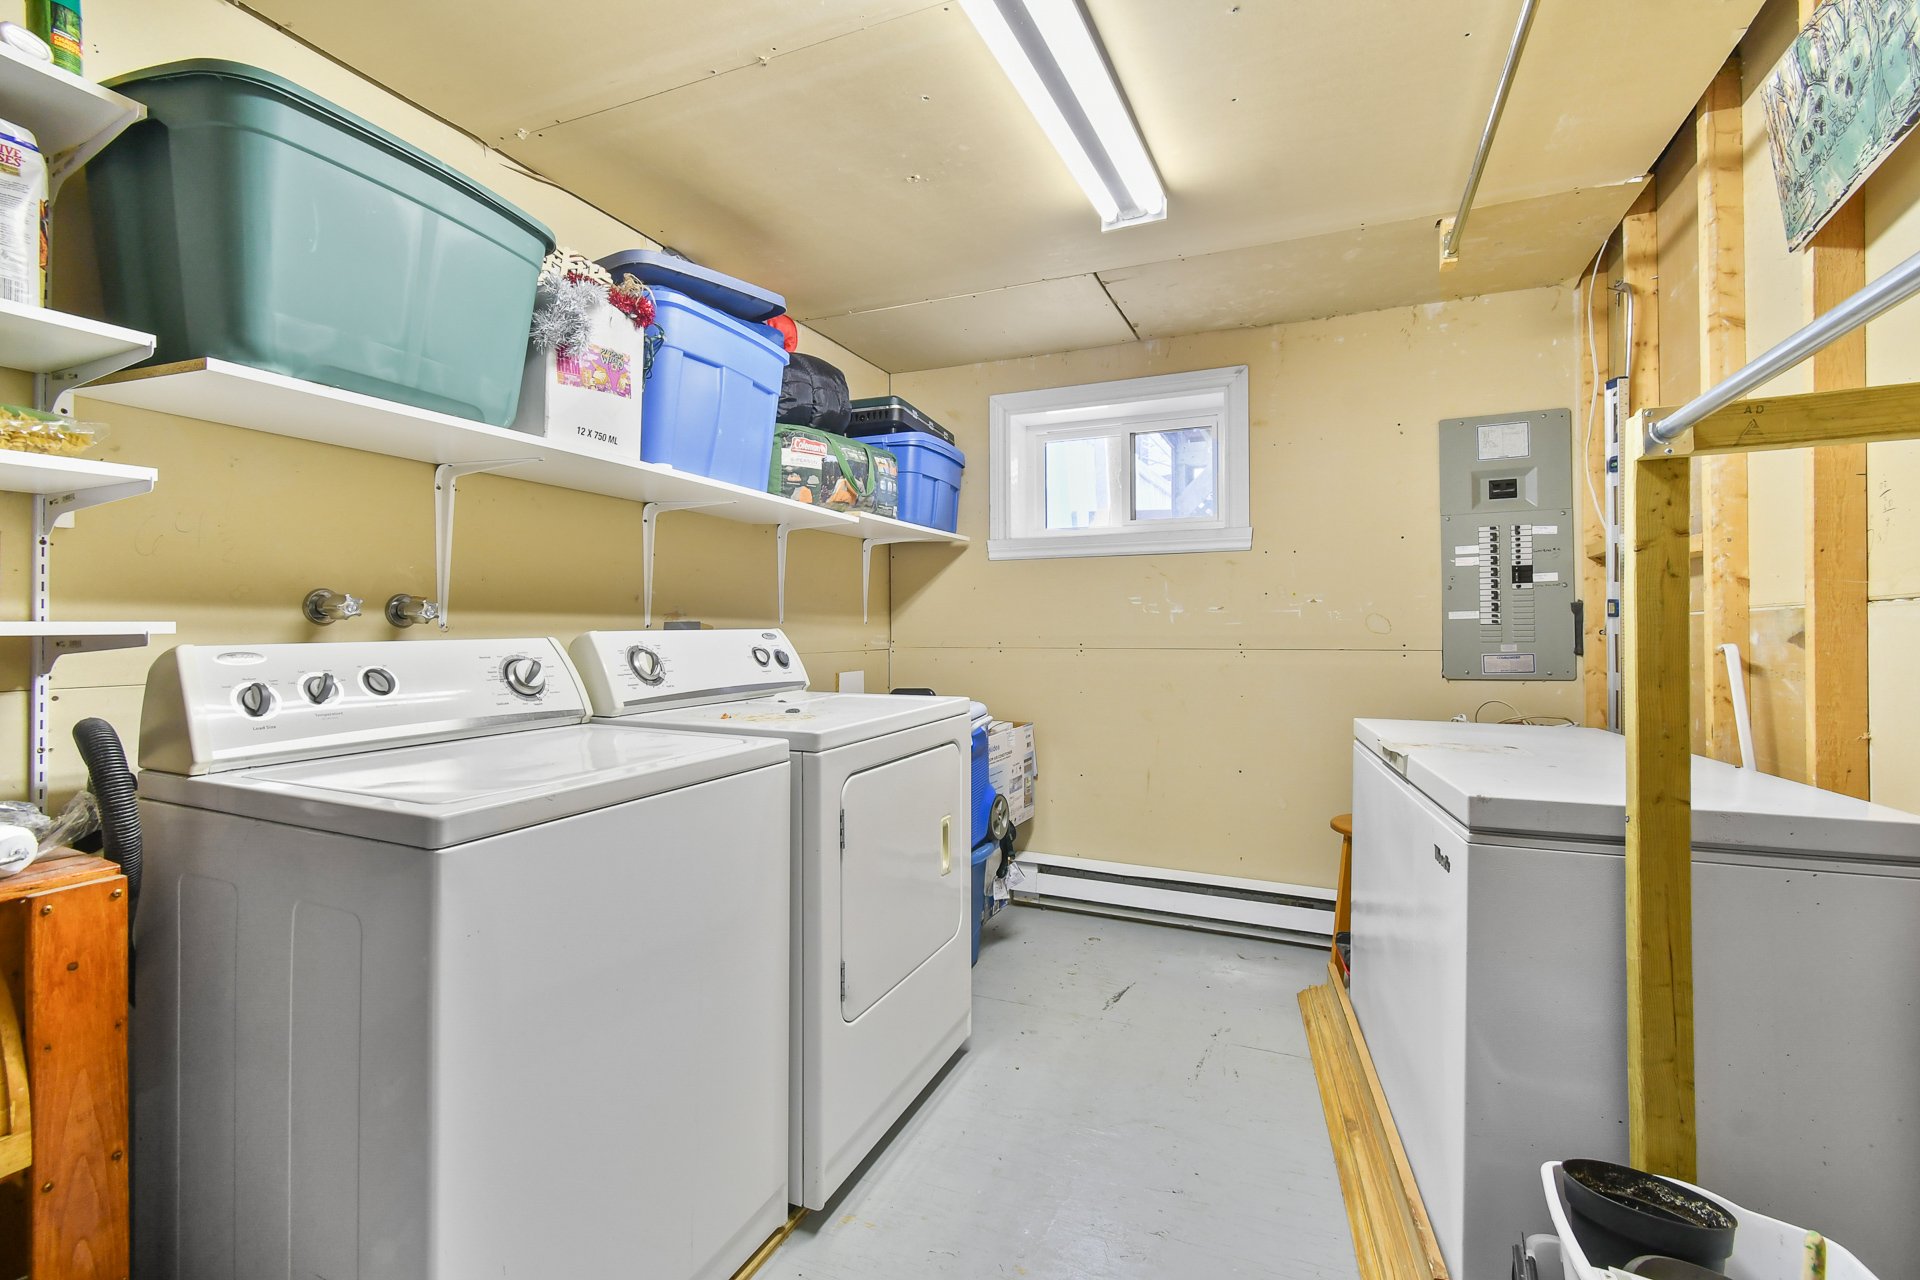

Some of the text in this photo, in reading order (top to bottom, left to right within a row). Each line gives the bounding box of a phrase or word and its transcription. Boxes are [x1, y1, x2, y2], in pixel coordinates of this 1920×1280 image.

[577, 426, 618, 445] 12 X 750 ML
[793, 438, 820, 453] Coleman
